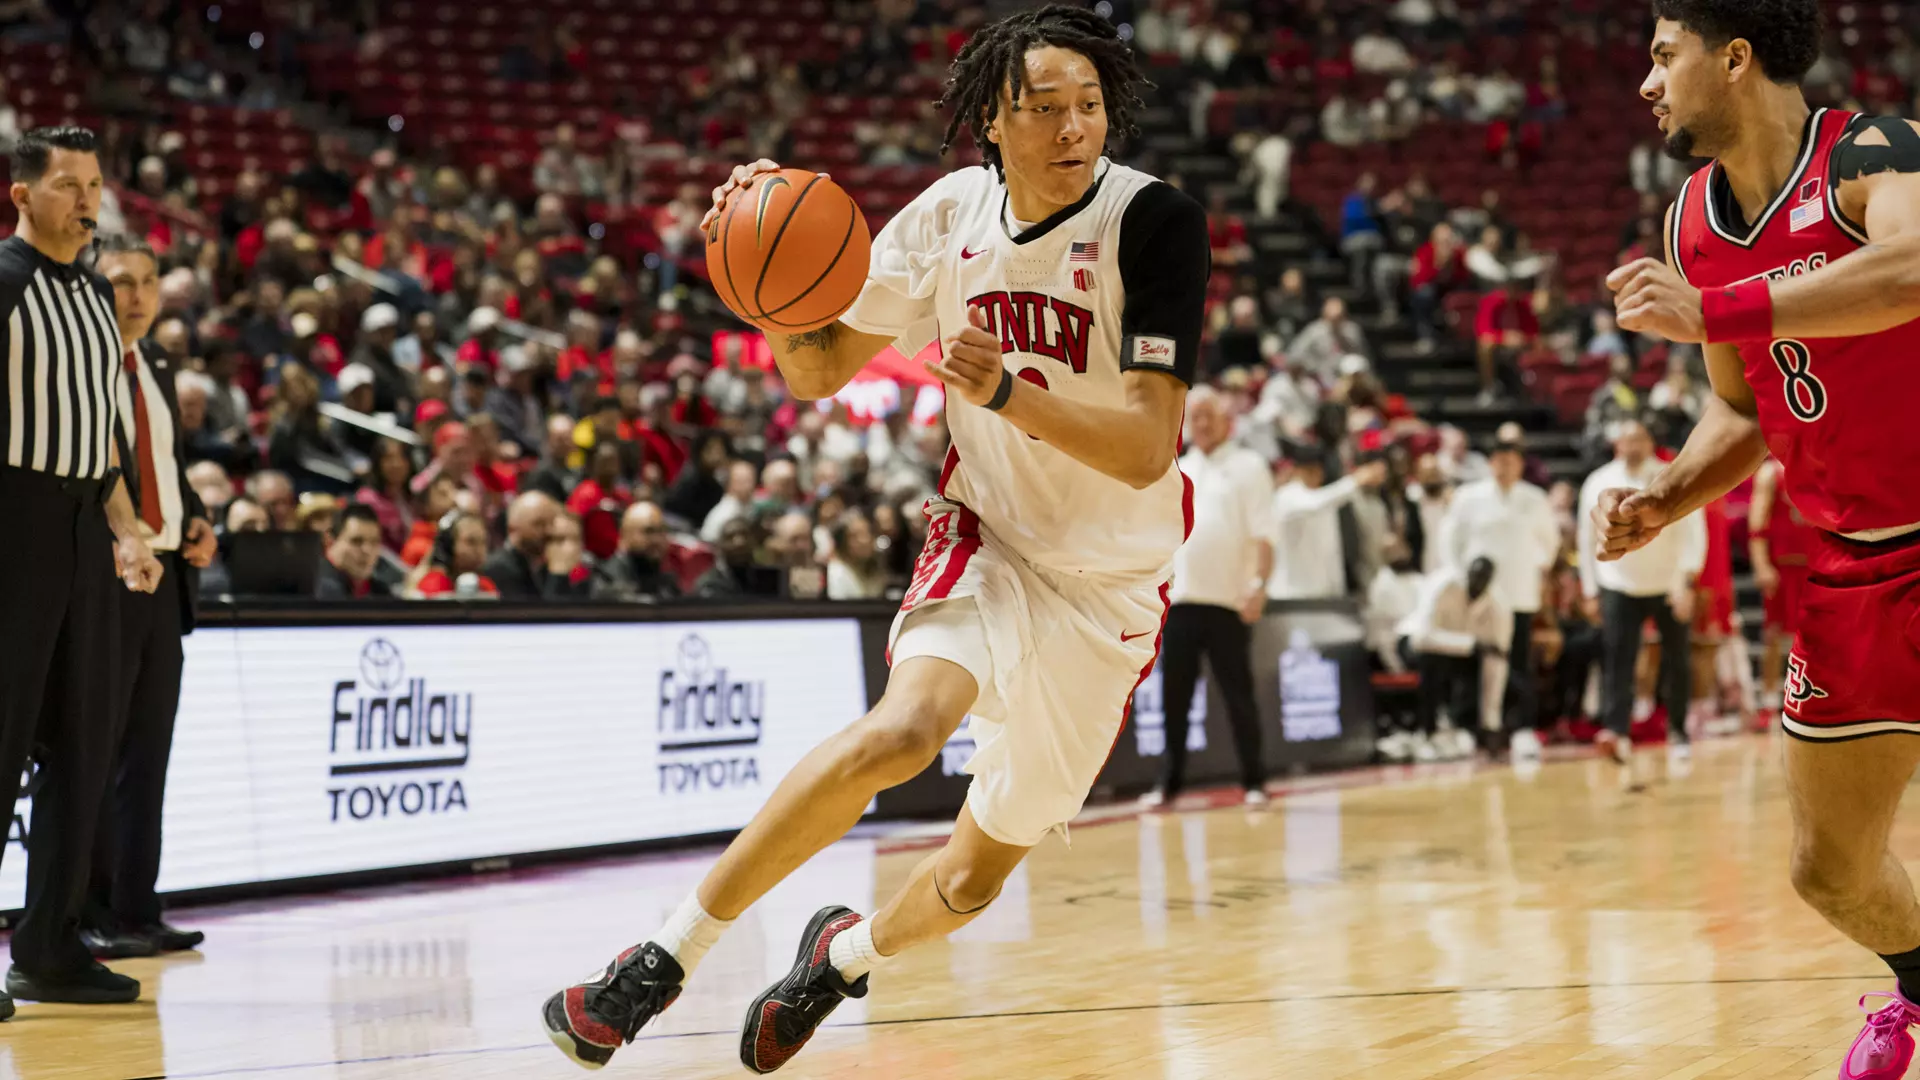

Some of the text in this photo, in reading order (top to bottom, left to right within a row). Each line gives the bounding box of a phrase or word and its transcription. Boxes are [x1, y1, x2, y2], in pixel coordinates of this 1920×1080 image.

[1769, 338, 1827, 422] 8
[330, 677, 472, 776] Findlay
[659, 668, 763, 752] Findlay
[327, 780, 467, 821] TOYOTA
[658, 758, 761, 793] TOYOTA
